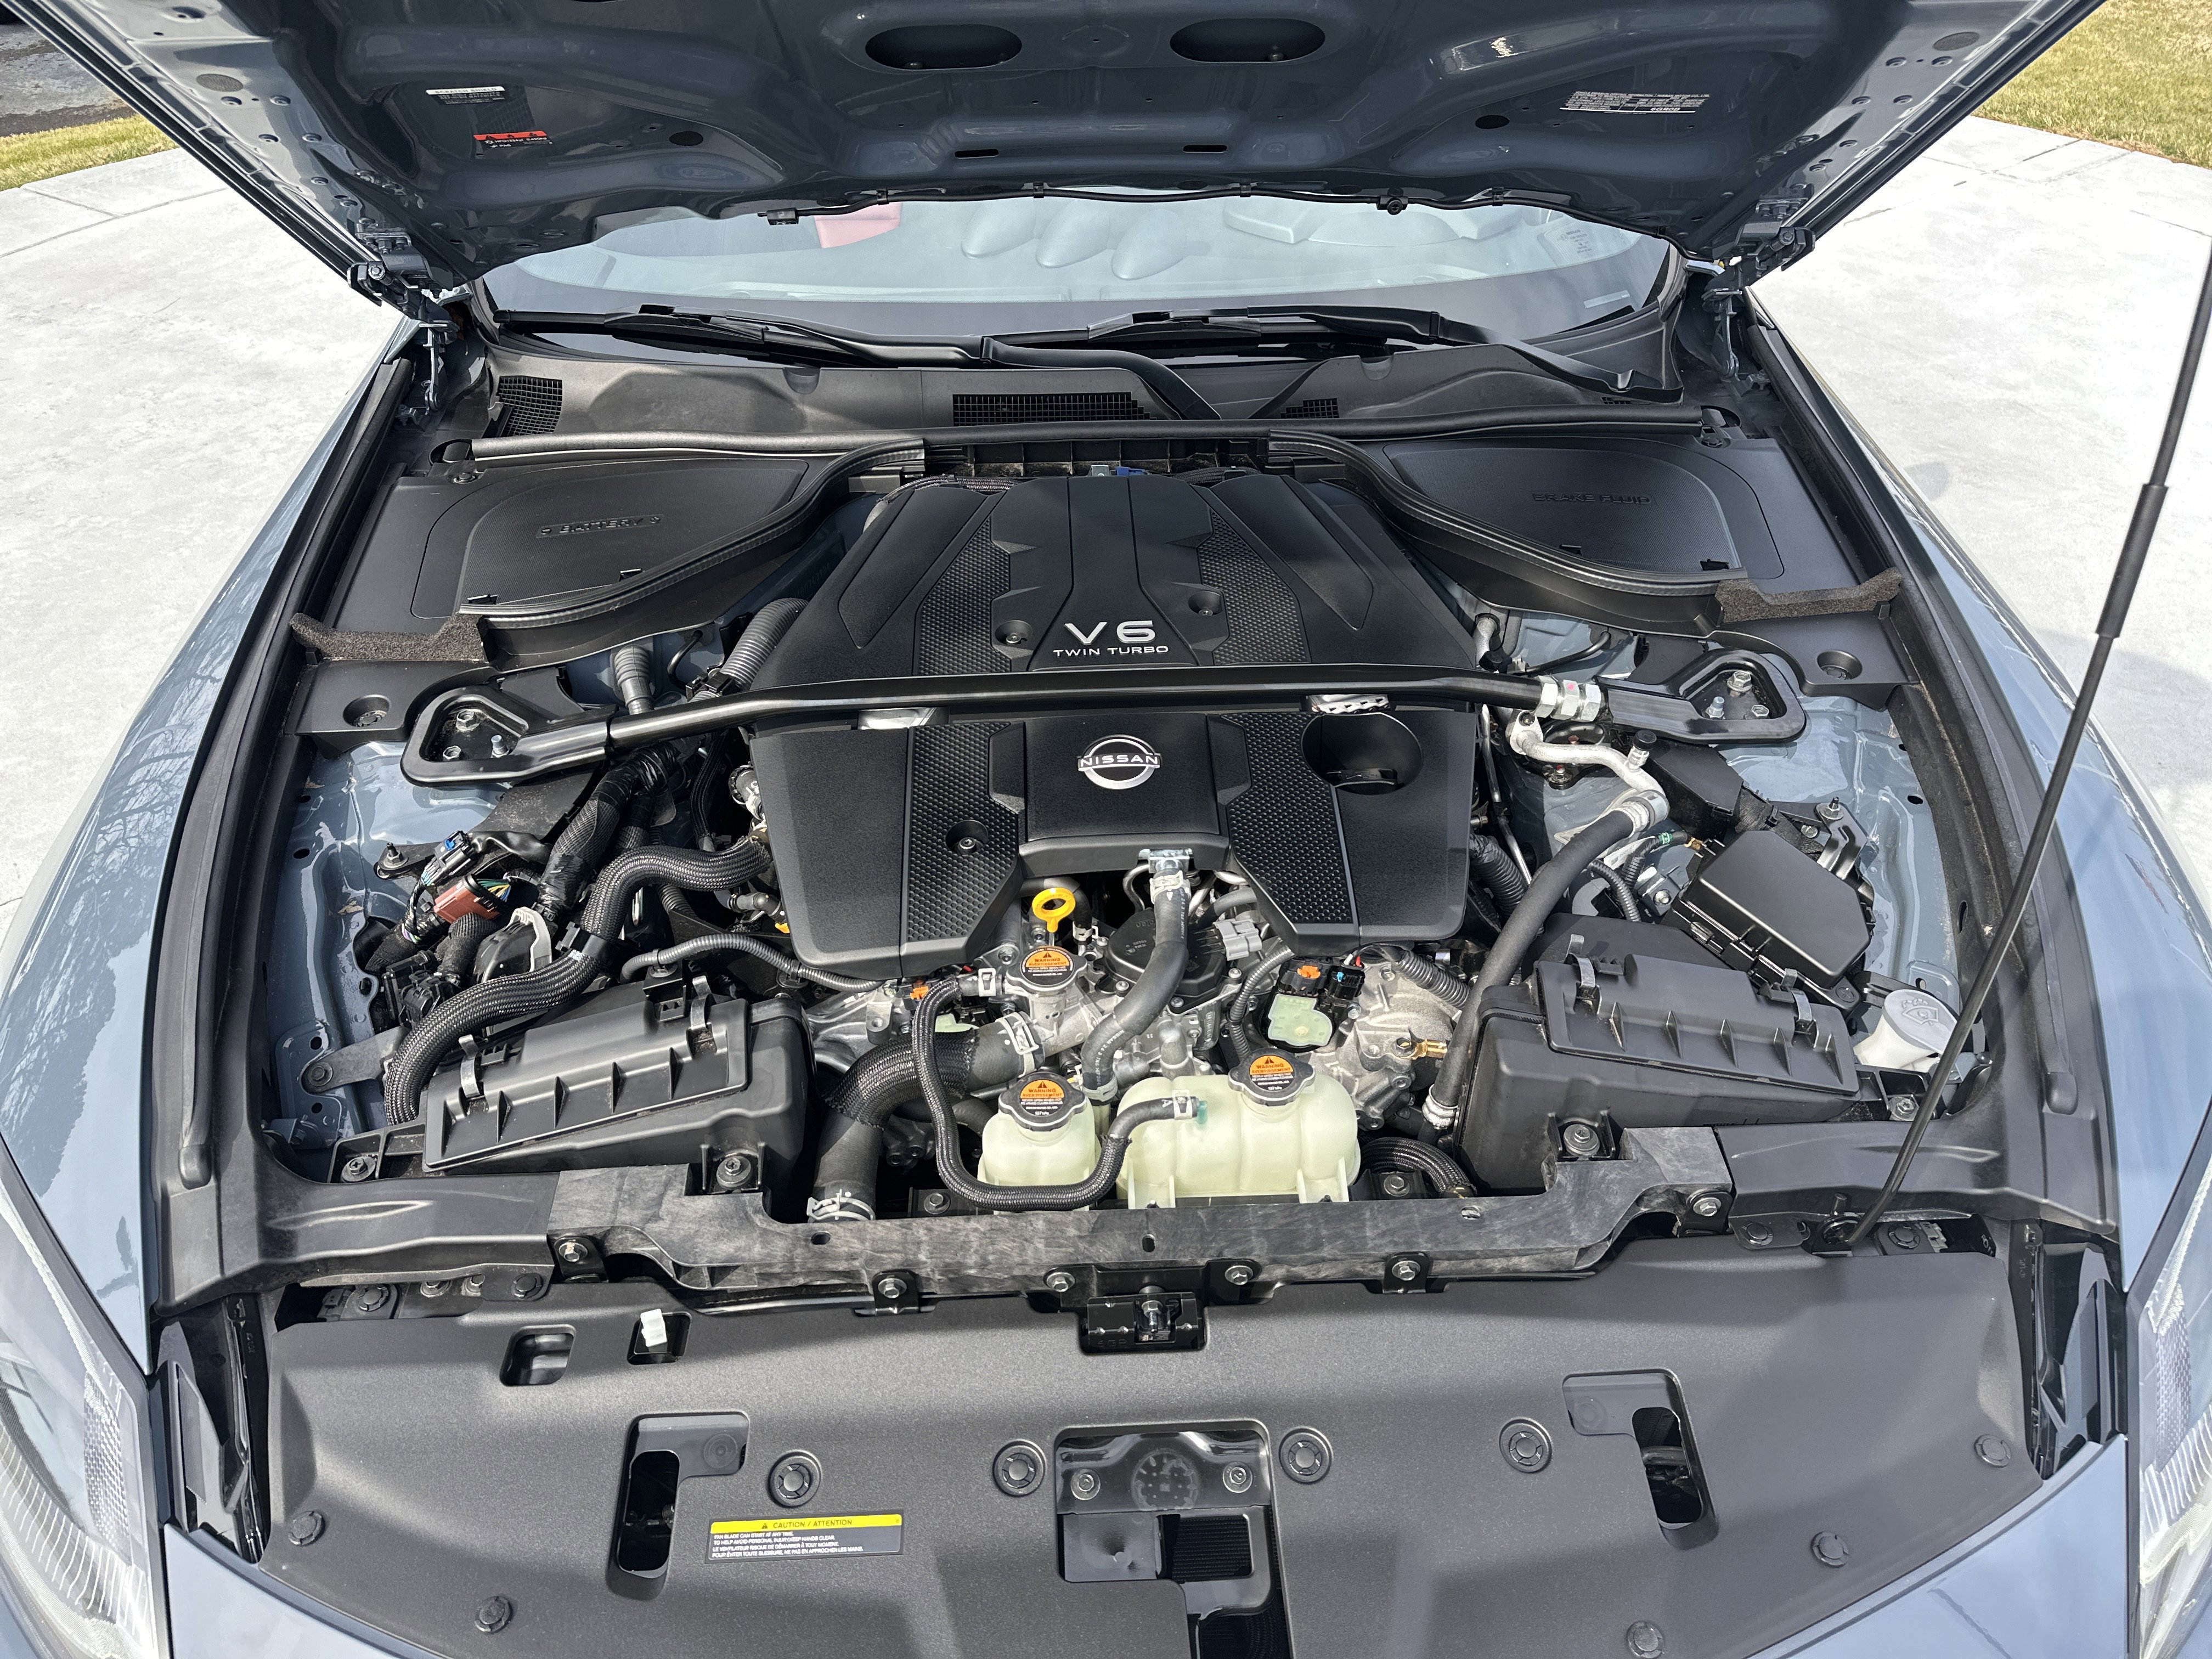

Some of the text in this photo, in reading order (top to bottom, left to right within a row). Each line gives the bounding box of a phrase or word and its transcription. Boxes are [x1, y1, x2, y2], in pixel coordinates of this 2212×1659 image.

[1532, 493, 1652, 504] BRAKE FLUID
[559, 517, 644, 533] BATTERY
[1064, 620, 1155, 645] V6
[1053, 646, 1169, 657] TWIN TURBO
[1080, 754, 1158, 767] NISSAN
[1107, 1029, 1125, 1044] NISSAN
